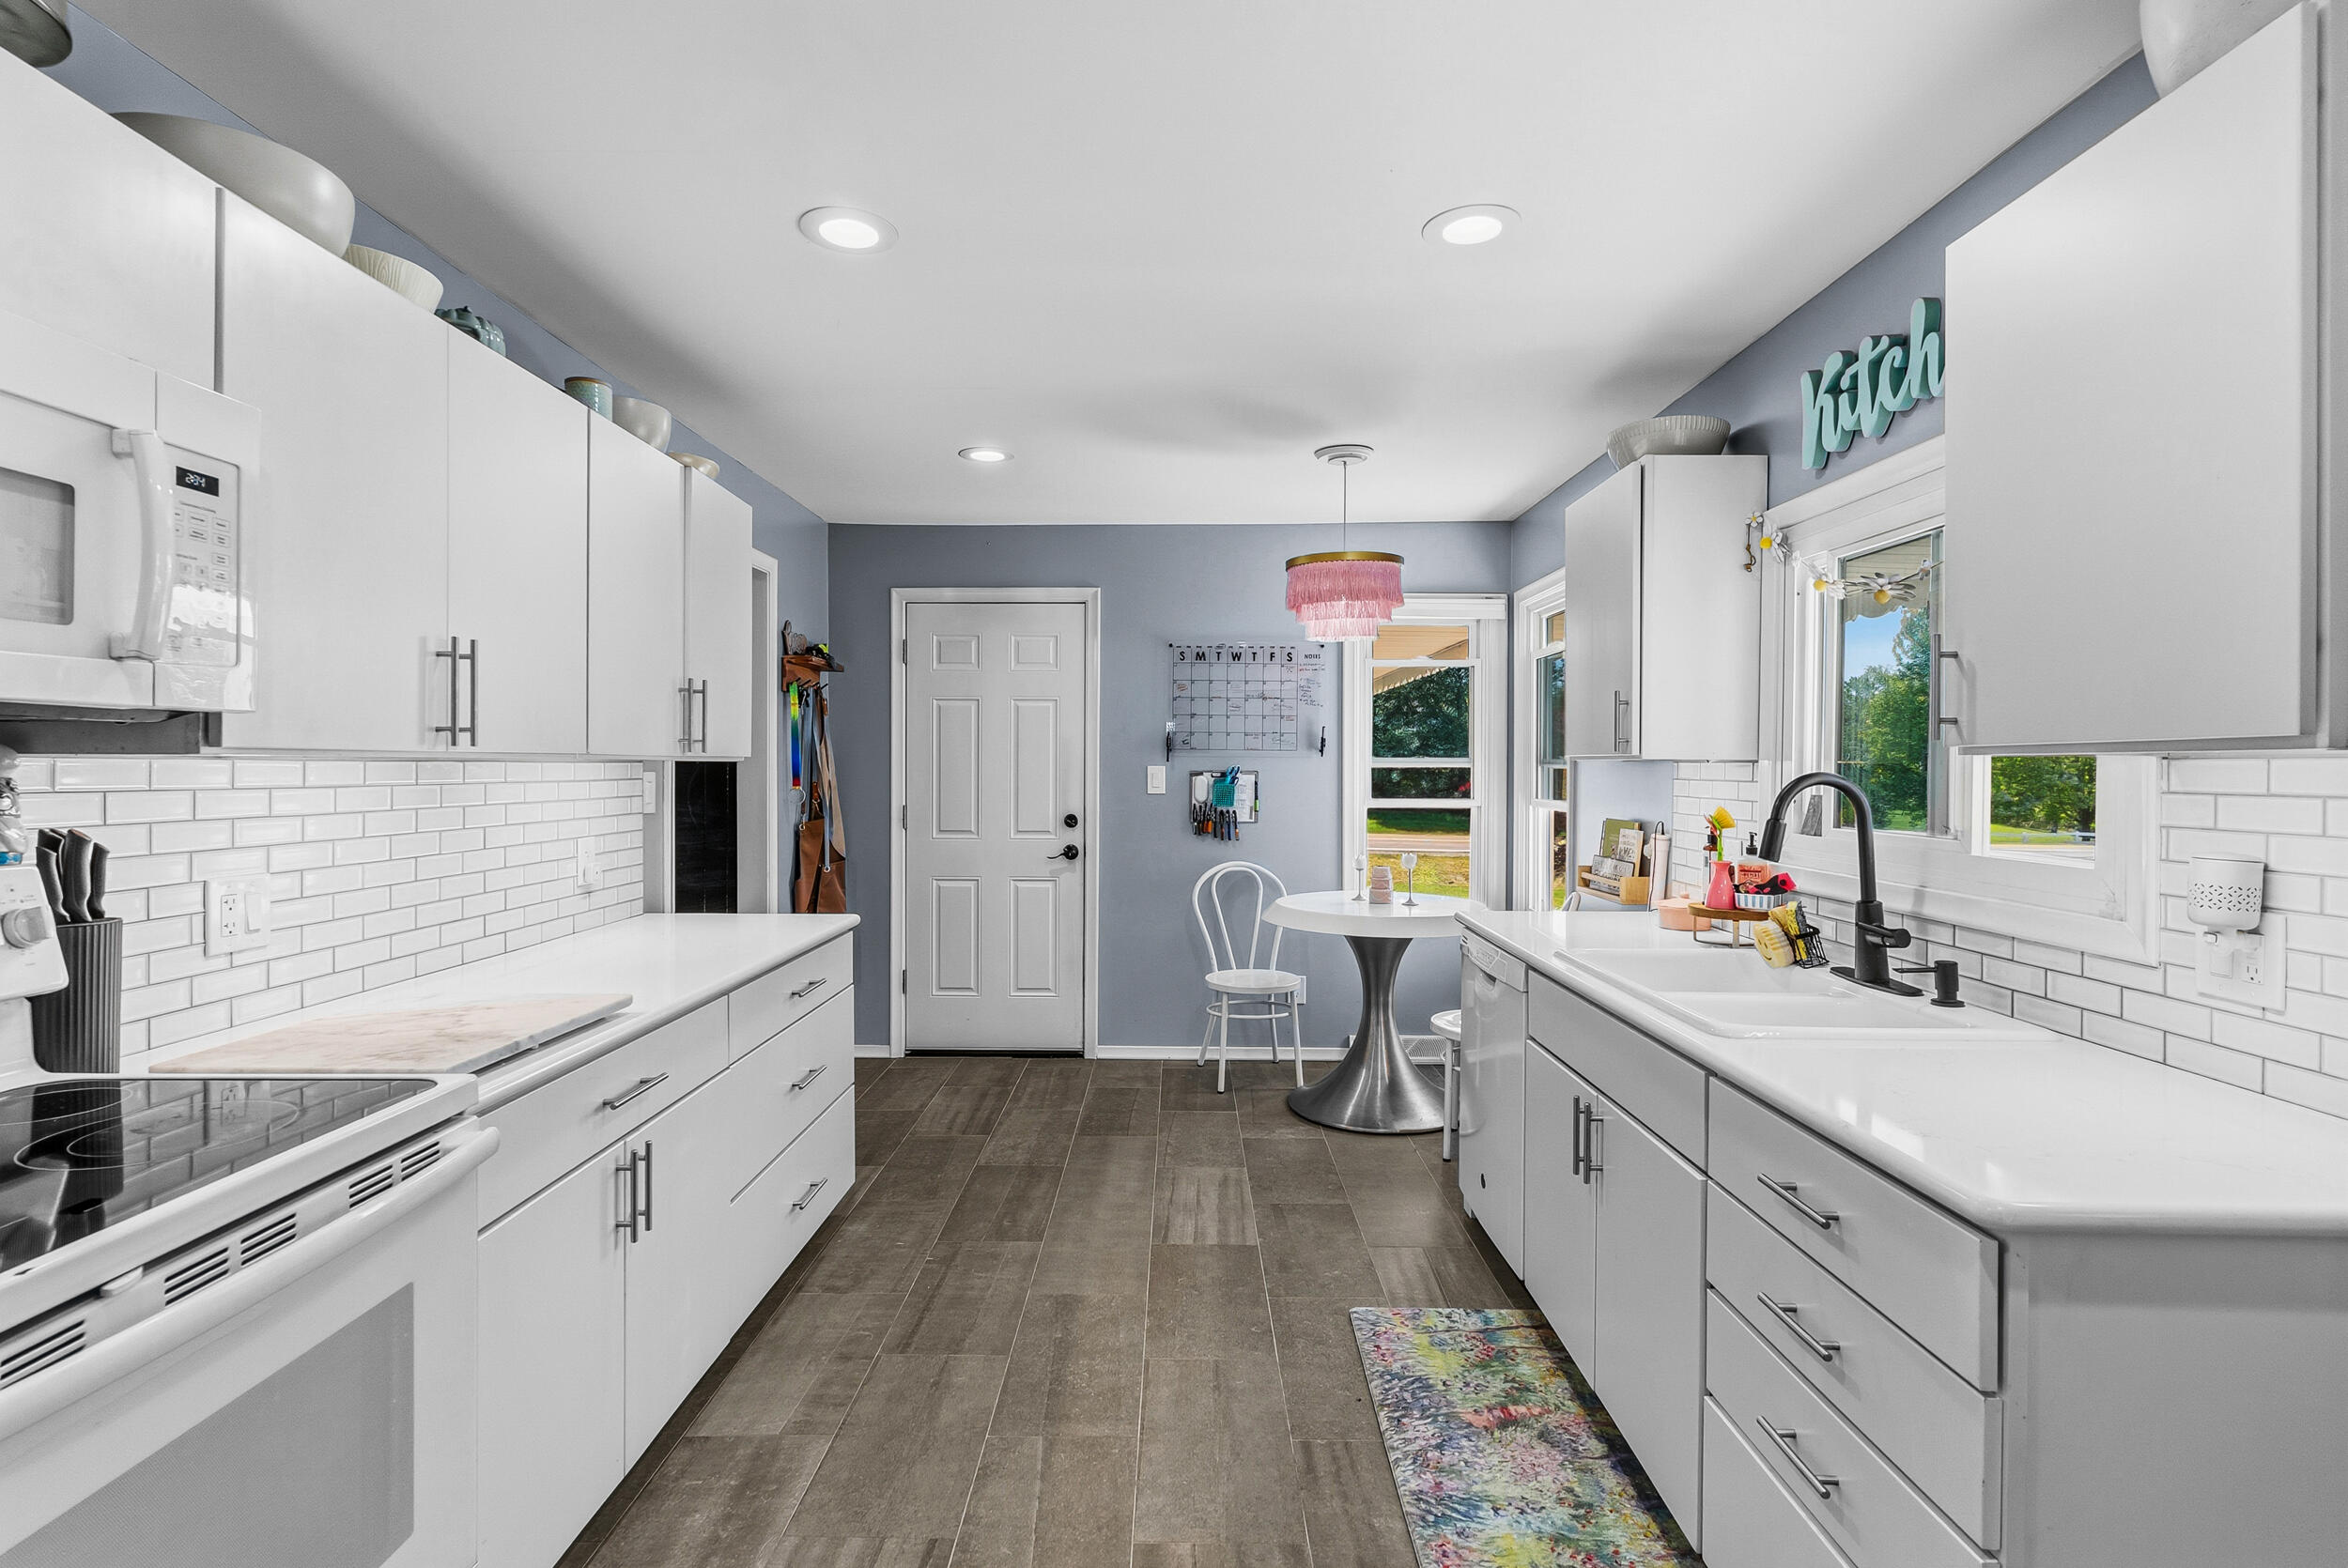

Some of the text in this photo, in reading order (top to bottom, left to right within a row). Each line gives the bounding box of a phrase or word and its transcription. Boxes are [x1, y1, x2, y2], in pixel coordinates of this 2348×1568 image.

[1179, 651, 1293, 662] S M T W T F S
